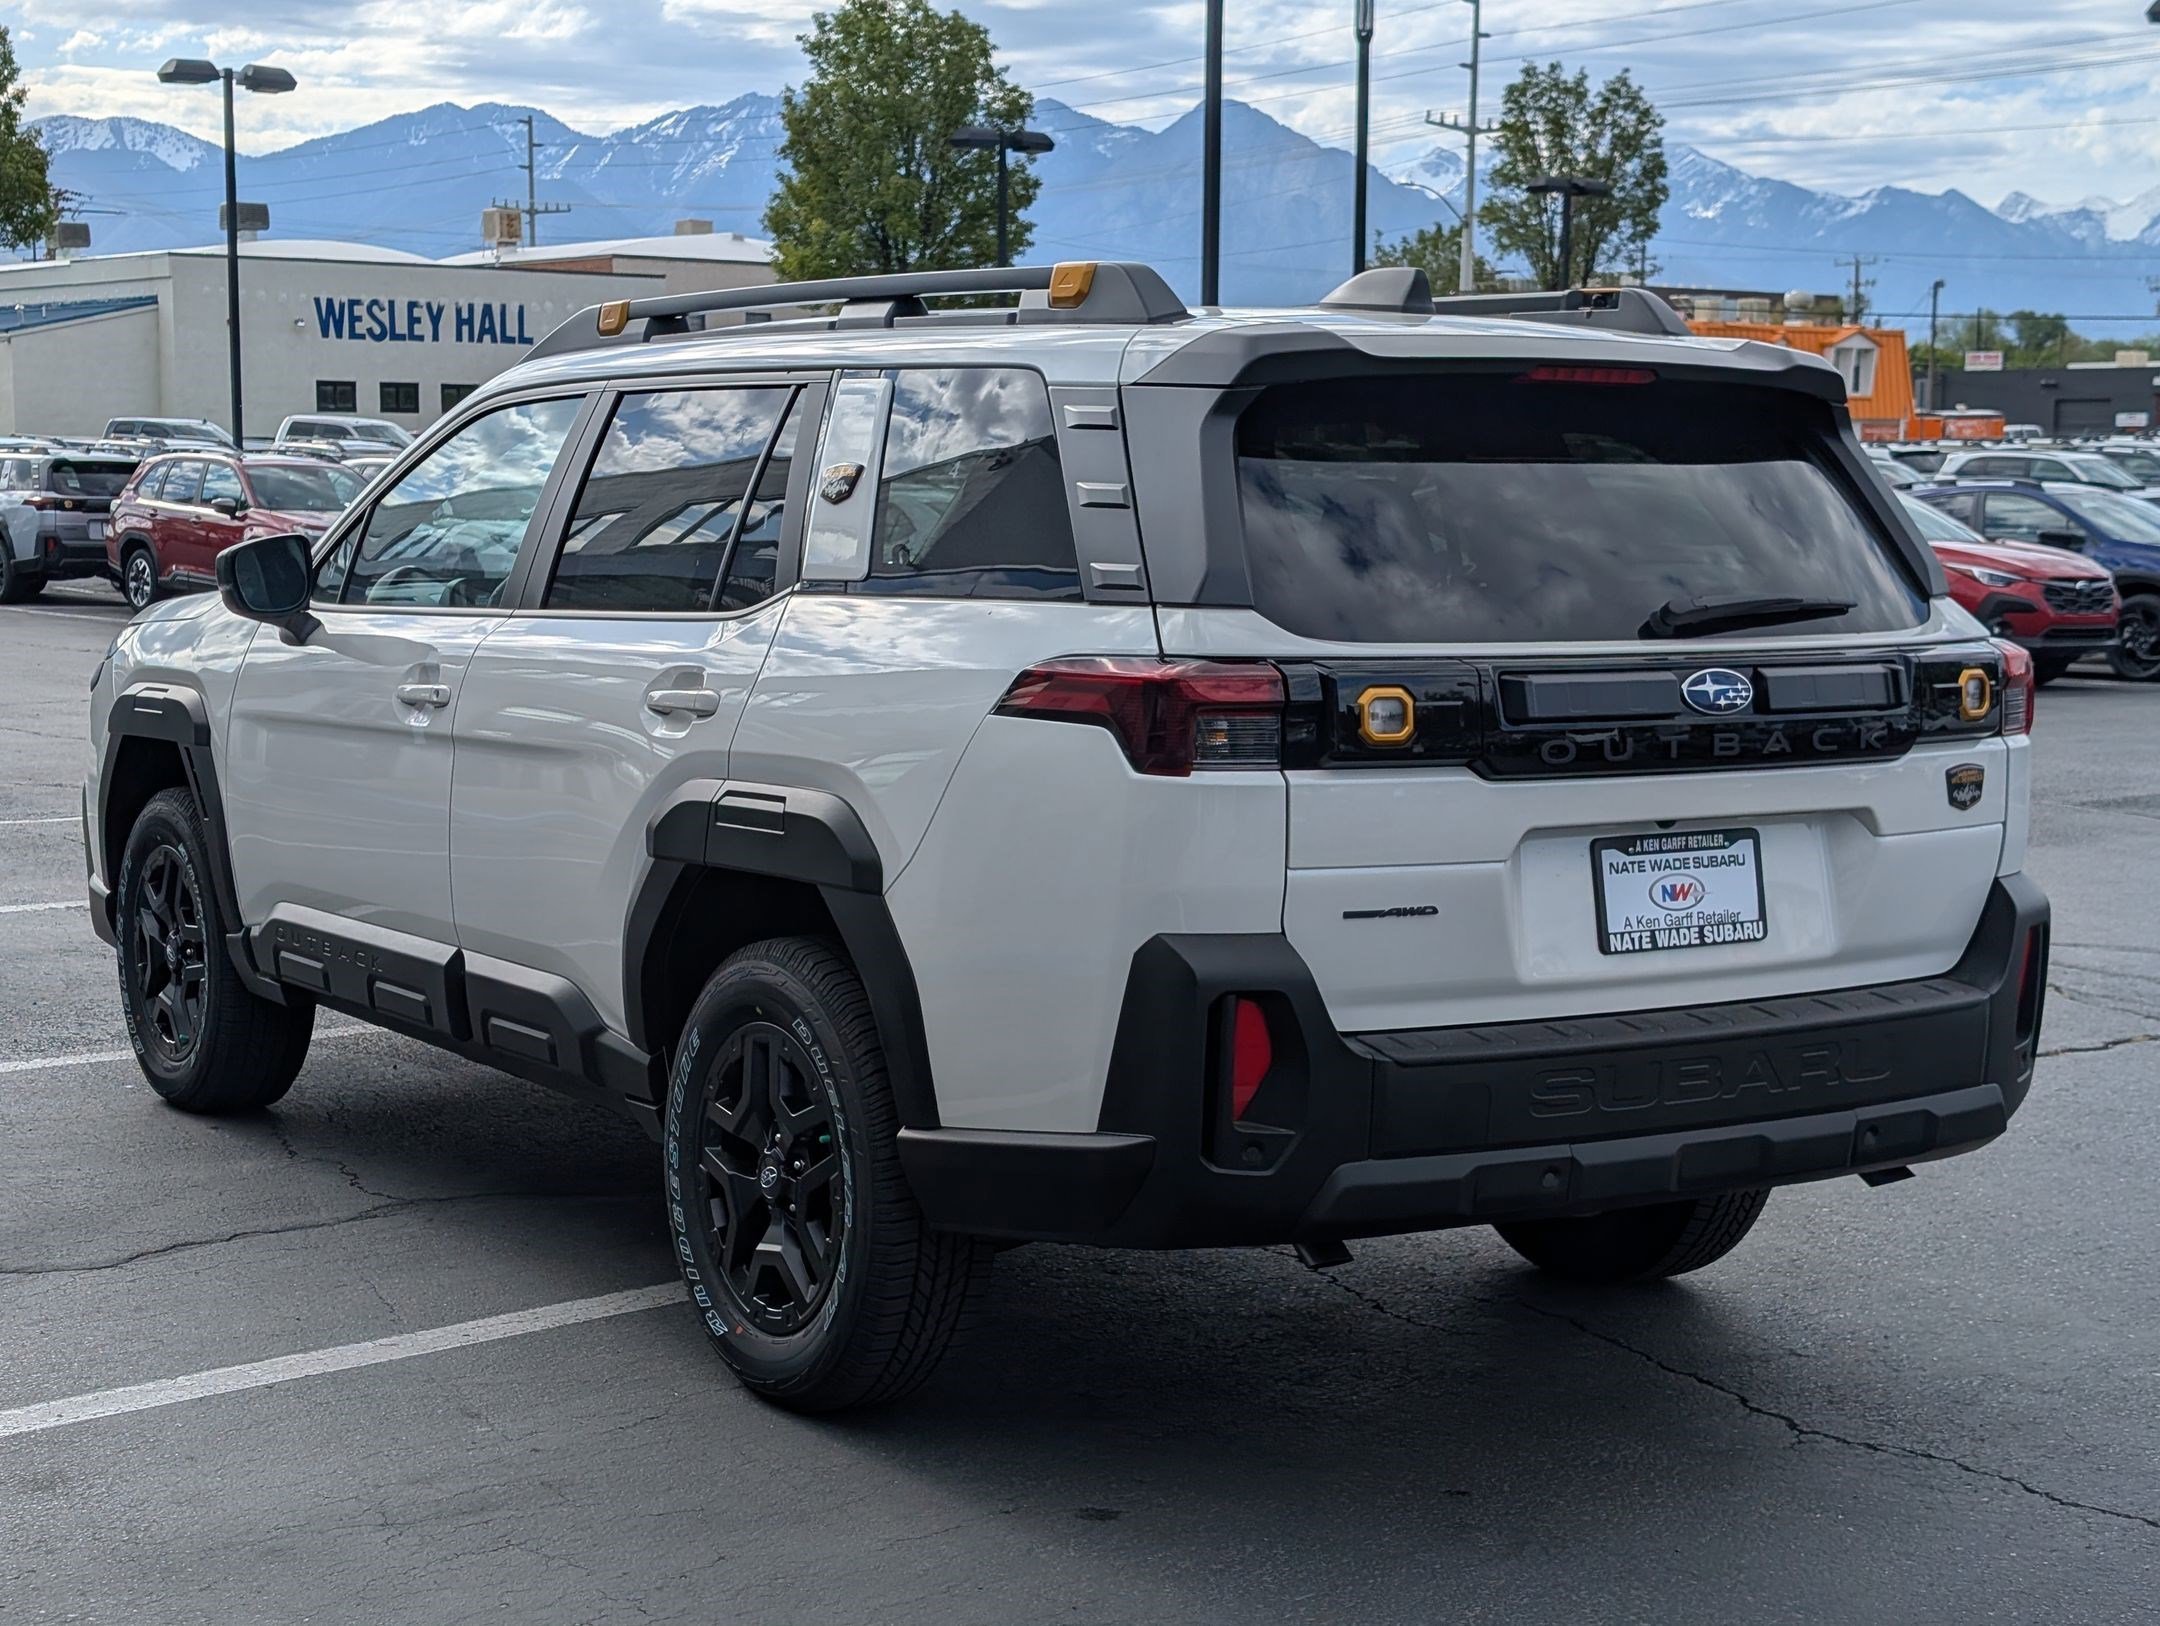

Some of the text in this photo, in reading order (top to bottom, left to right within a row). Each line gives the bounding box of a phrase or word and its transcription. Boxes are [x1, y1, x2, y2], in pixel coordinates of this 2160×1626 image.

[313, 297, 534, 345] WESLEY HALL
[1541, 728, 1888, 764] OUTBACK
[1635, 834, 1724, 852] A KEN GARFF RETAILER
[1609, 853, 1746, 875] NATE WADE SUBARU
[1660, 882, 1694, 903] NW
[1378, 905, 1439, 918] AWD
[1623, 909, 1741, 930] A Ken Garff Retailer
[1609, 921, 1764, 952] NATE WADE SUBARU
[275, 927, 383, 973] OUTBACK
[668, 1026, 729, 1337] BRIDGESTONE
